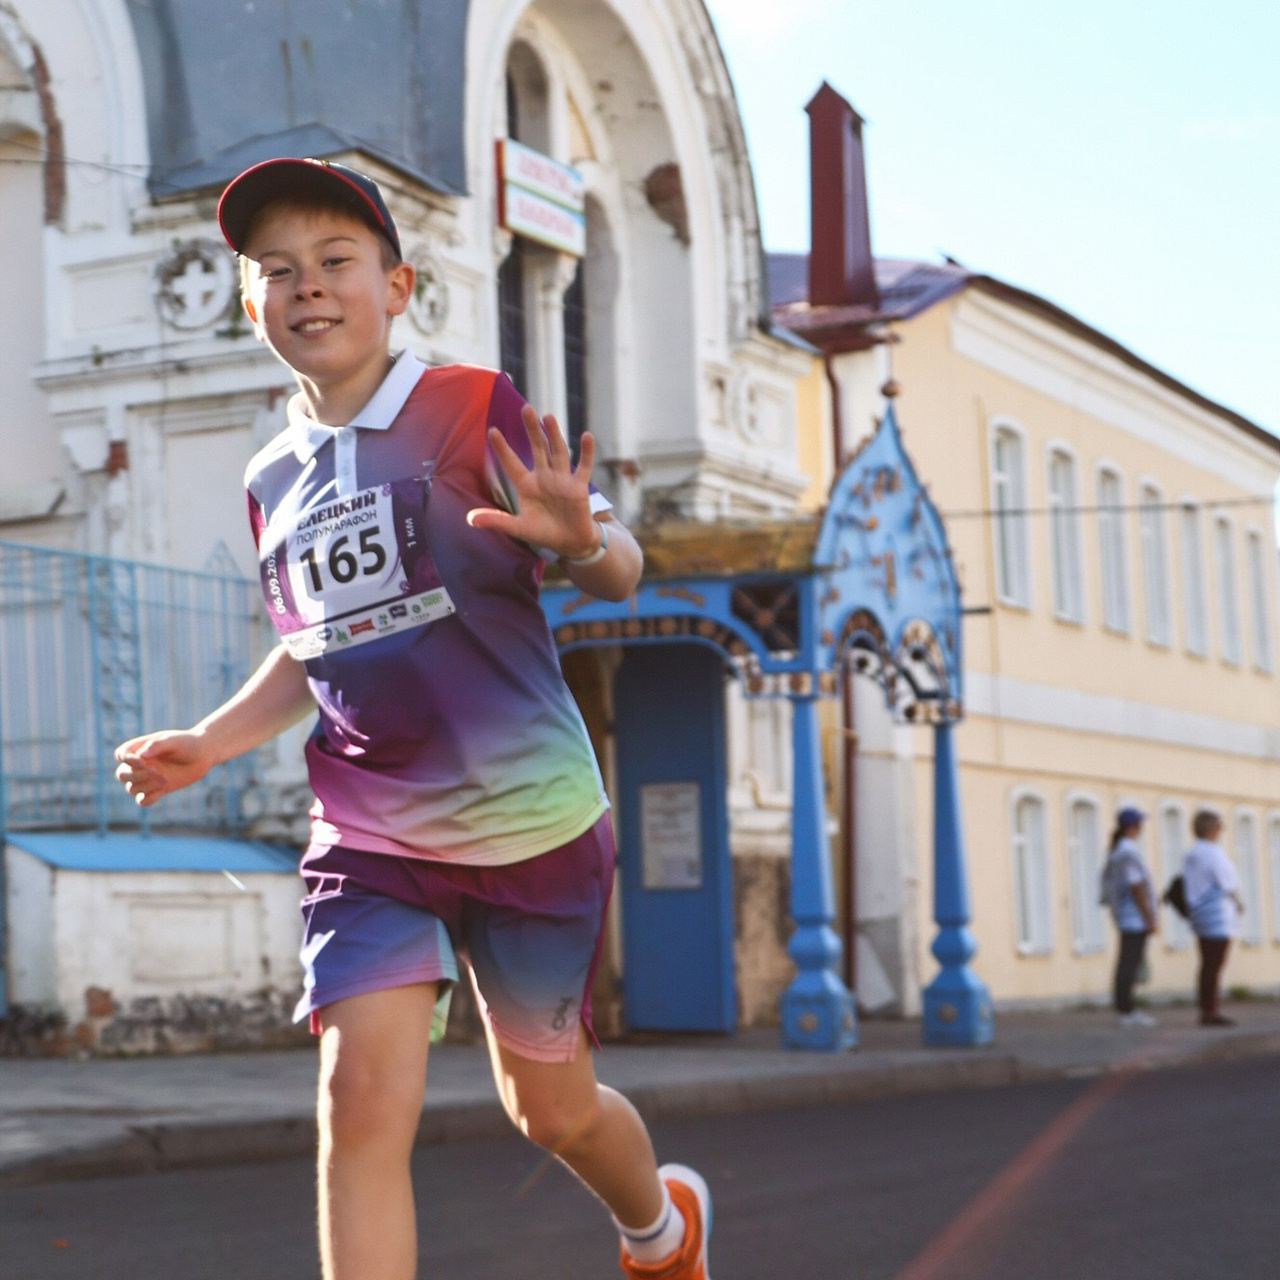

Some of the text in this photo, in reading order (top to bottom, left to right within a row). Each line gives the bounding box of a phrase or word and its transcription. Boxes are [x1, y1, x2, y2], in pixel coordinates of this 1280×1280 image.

[296, 509, 377, 546] ПОЛУМАРАФОН
[297, 490, 377, 531] ЕЛЕЦКИЙ
[299, 525, 387, 593] 165
[406, 540, 417, 548] 1
[266, 549, 287, 615] 06.09.202
